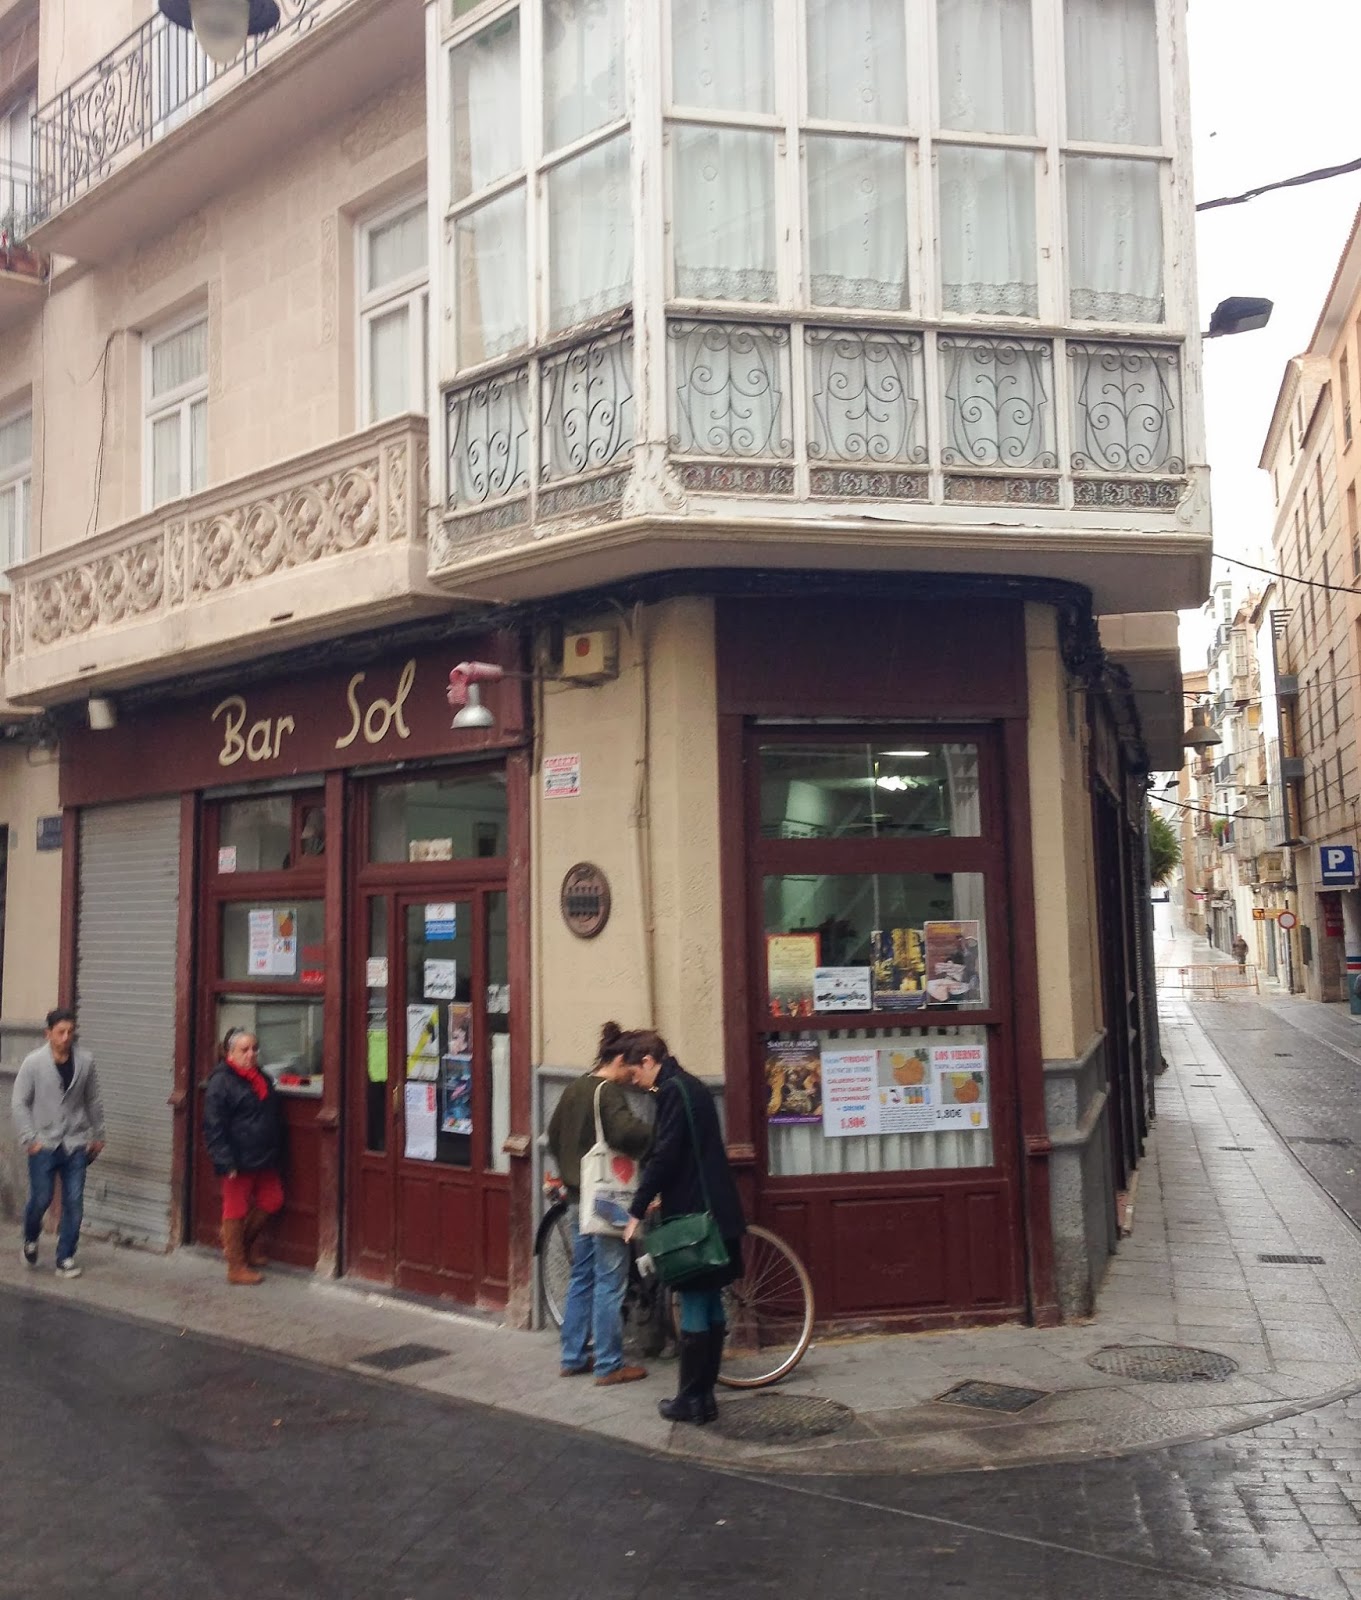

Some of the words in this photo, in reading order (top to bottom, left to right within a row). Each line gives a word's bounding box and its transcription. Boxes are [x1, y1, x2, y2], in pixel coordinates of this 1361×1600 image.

[211, 695, 295, 766] Bar
[335, 658, 416, 749] Sol
[1328, 850, 1346, 870] P
[935, 1051, 949, 1061] LOS
